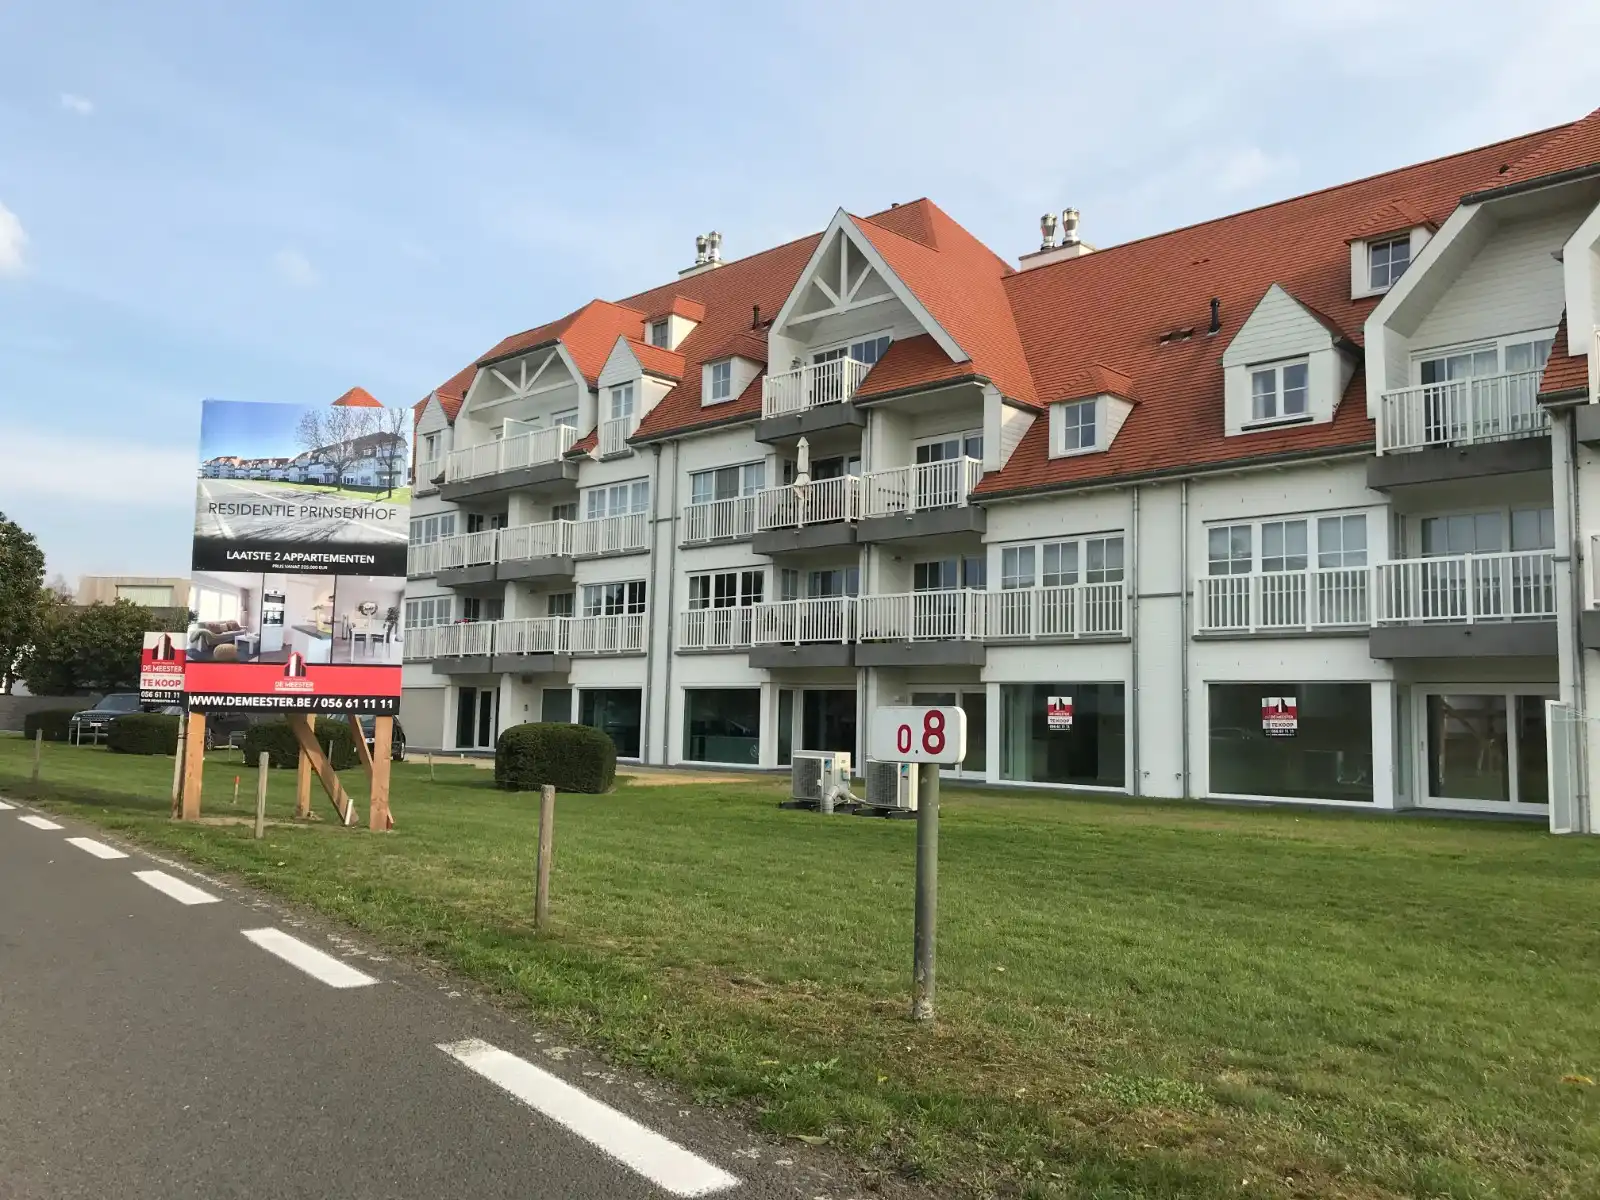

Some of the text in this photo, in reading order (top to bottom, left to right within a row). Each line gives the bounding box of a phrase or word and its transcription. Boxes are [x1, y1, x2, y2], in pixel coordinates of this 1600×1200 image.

[208, 502, 396, 520] RESIDENTIE PRINSENHOF
[226, 550, 375, 564] LAATSTE 2 APPARTEMENTEN
[142, 664, 183, 673] DE MEESTER
[143, 678, 182, 688] TE KOOP
[140, 690, 154, 698] 056
[164, 691, 172, 699] 11
[189, 695, 311, 708] WWW.DEMEESTER.BE
[312, 697, 319, 708] /
[320, 698, 343, 709] 056
[345, 698, 359, 709] 61
[362, 699, 376, 709] 11
[380, 699, 394, 709] 11
